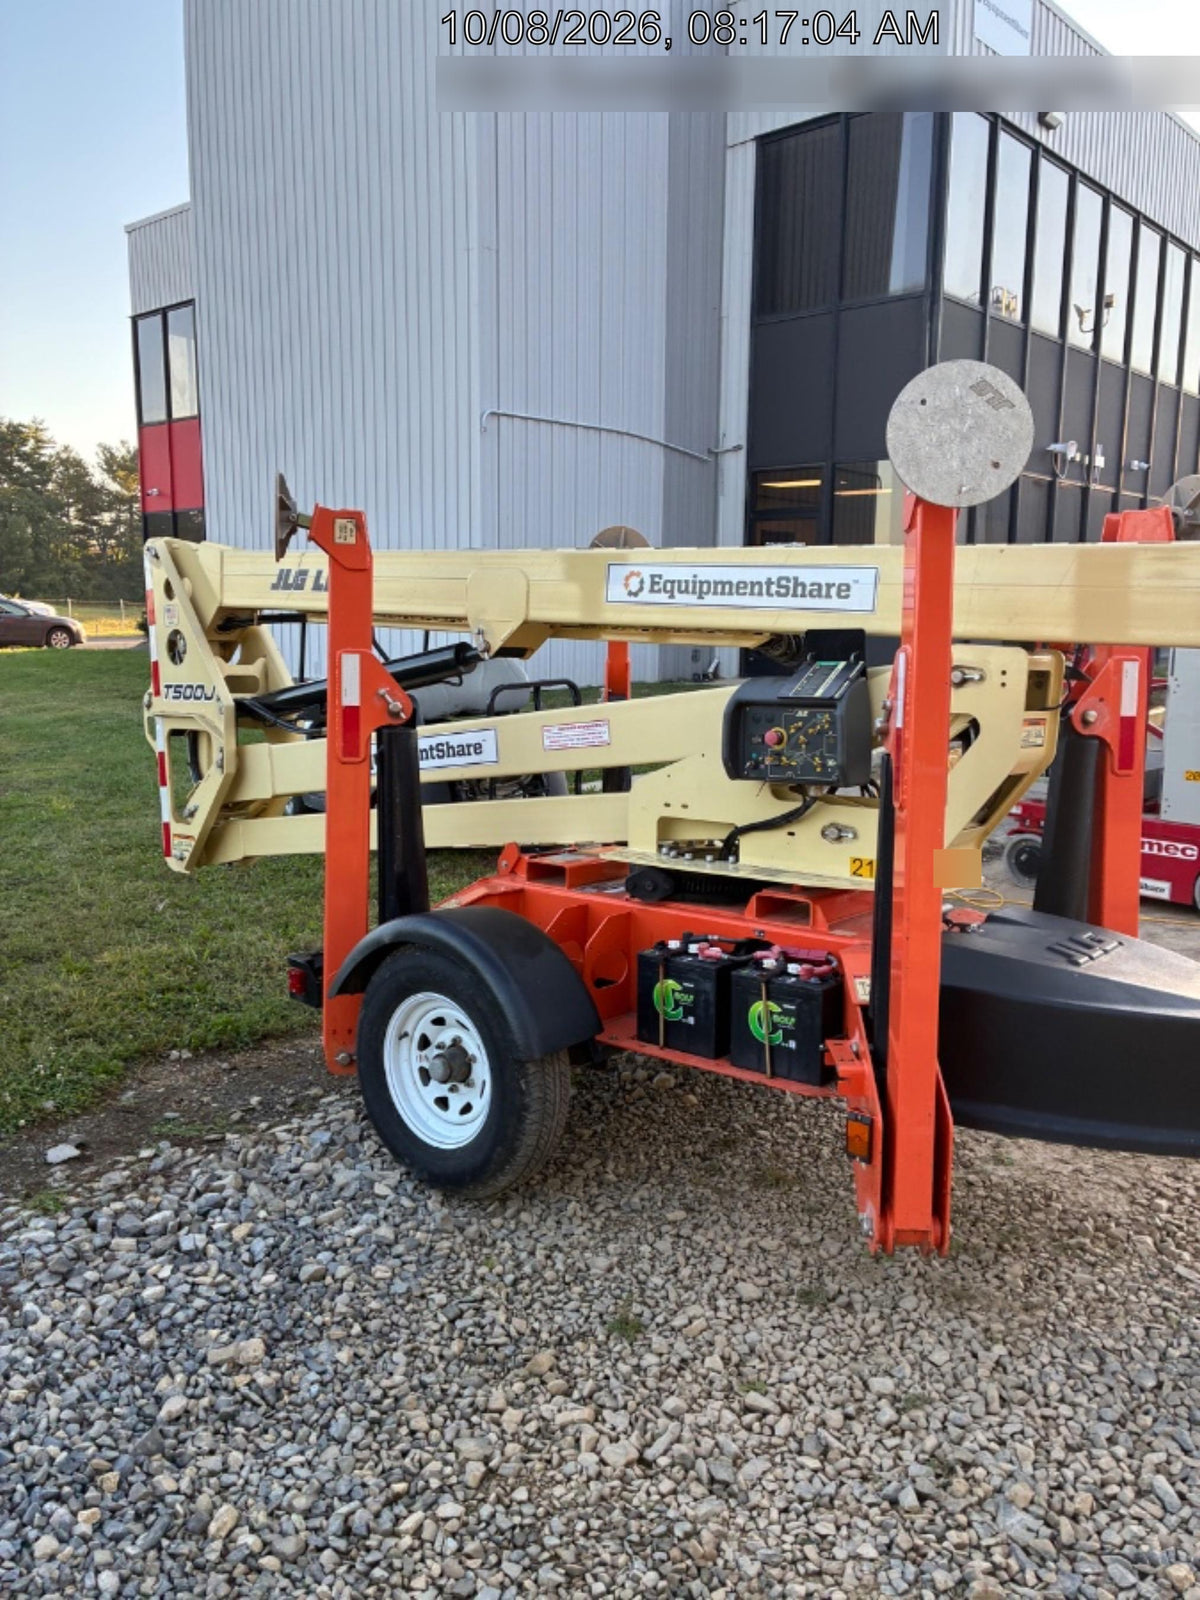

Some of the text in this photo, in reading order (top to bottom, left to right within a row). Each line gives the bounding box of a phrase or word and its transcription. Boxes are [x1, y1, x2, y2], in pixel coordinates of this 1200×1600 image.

[270, 568, 310, 591] JLG
[648, 573, 852, 600] EquipmentShare
[163, 684, 216, 701] T500J
